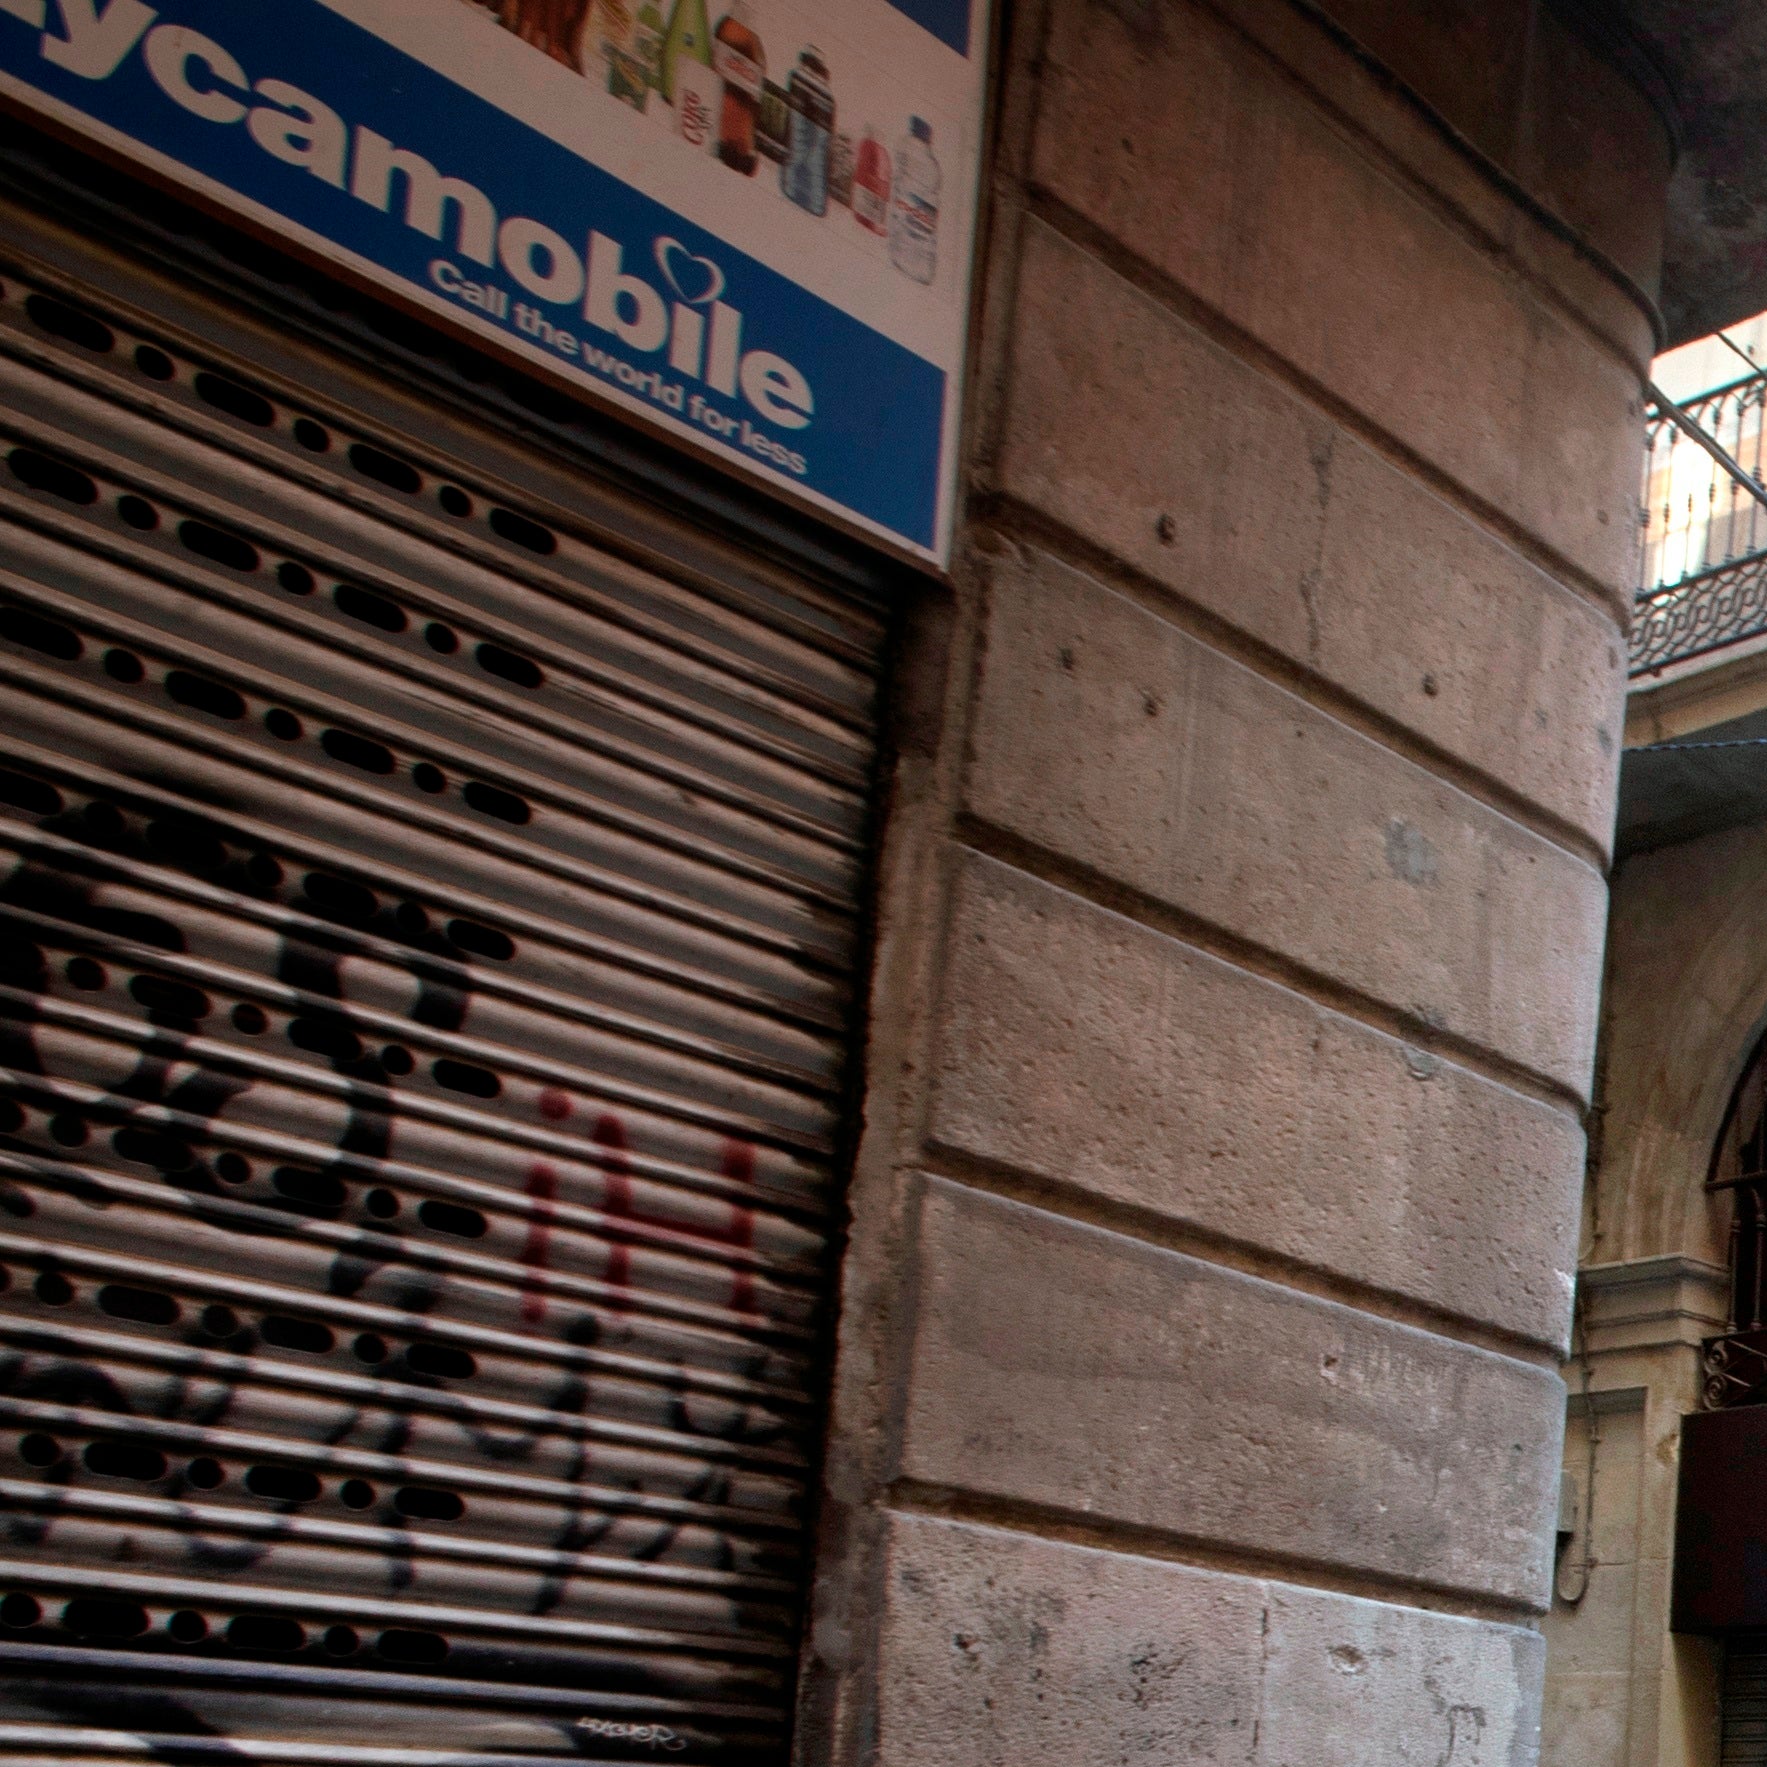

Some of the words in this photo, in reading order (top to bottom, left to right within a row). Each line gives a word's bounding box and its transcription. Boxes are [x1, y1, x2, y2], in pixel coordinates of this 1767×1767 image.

[0, 0, 815, 430] ycamobile
[428, 259, 509, 320] Call
[513, 300, 579, 356] the
[582, 340, 686, 412] world
[688, 394, 741, 438] for
[739, 420, 808, 476] less
